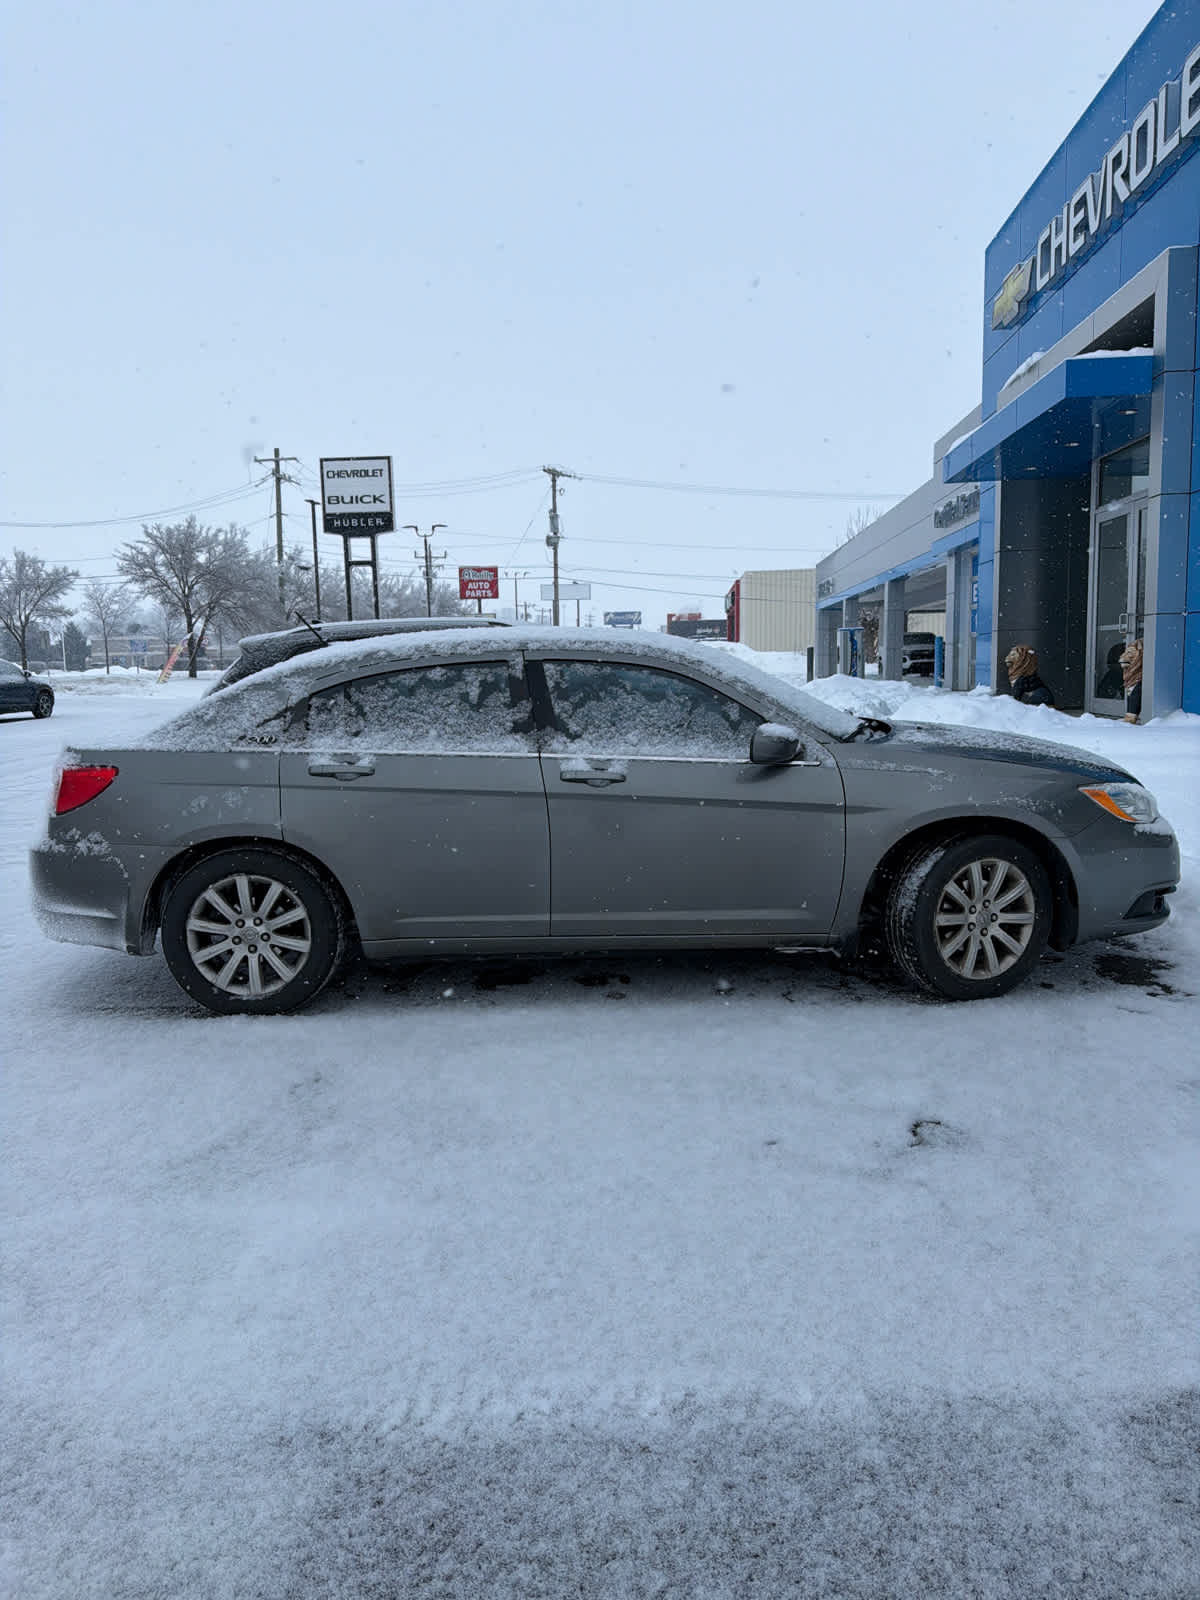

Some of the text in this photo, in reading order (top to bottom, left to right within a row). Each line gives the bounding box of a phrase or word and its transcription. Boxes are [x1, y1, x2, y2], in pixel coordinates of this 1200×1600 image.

[326, 468, 384, 479] CHEVROLET
[327, 494, 386, 505] BUICK
[333, 518, 385, 527] HUBLER
[468, 581, 490, 590] AUTO
[465, 590, 493, 598] PARTS
